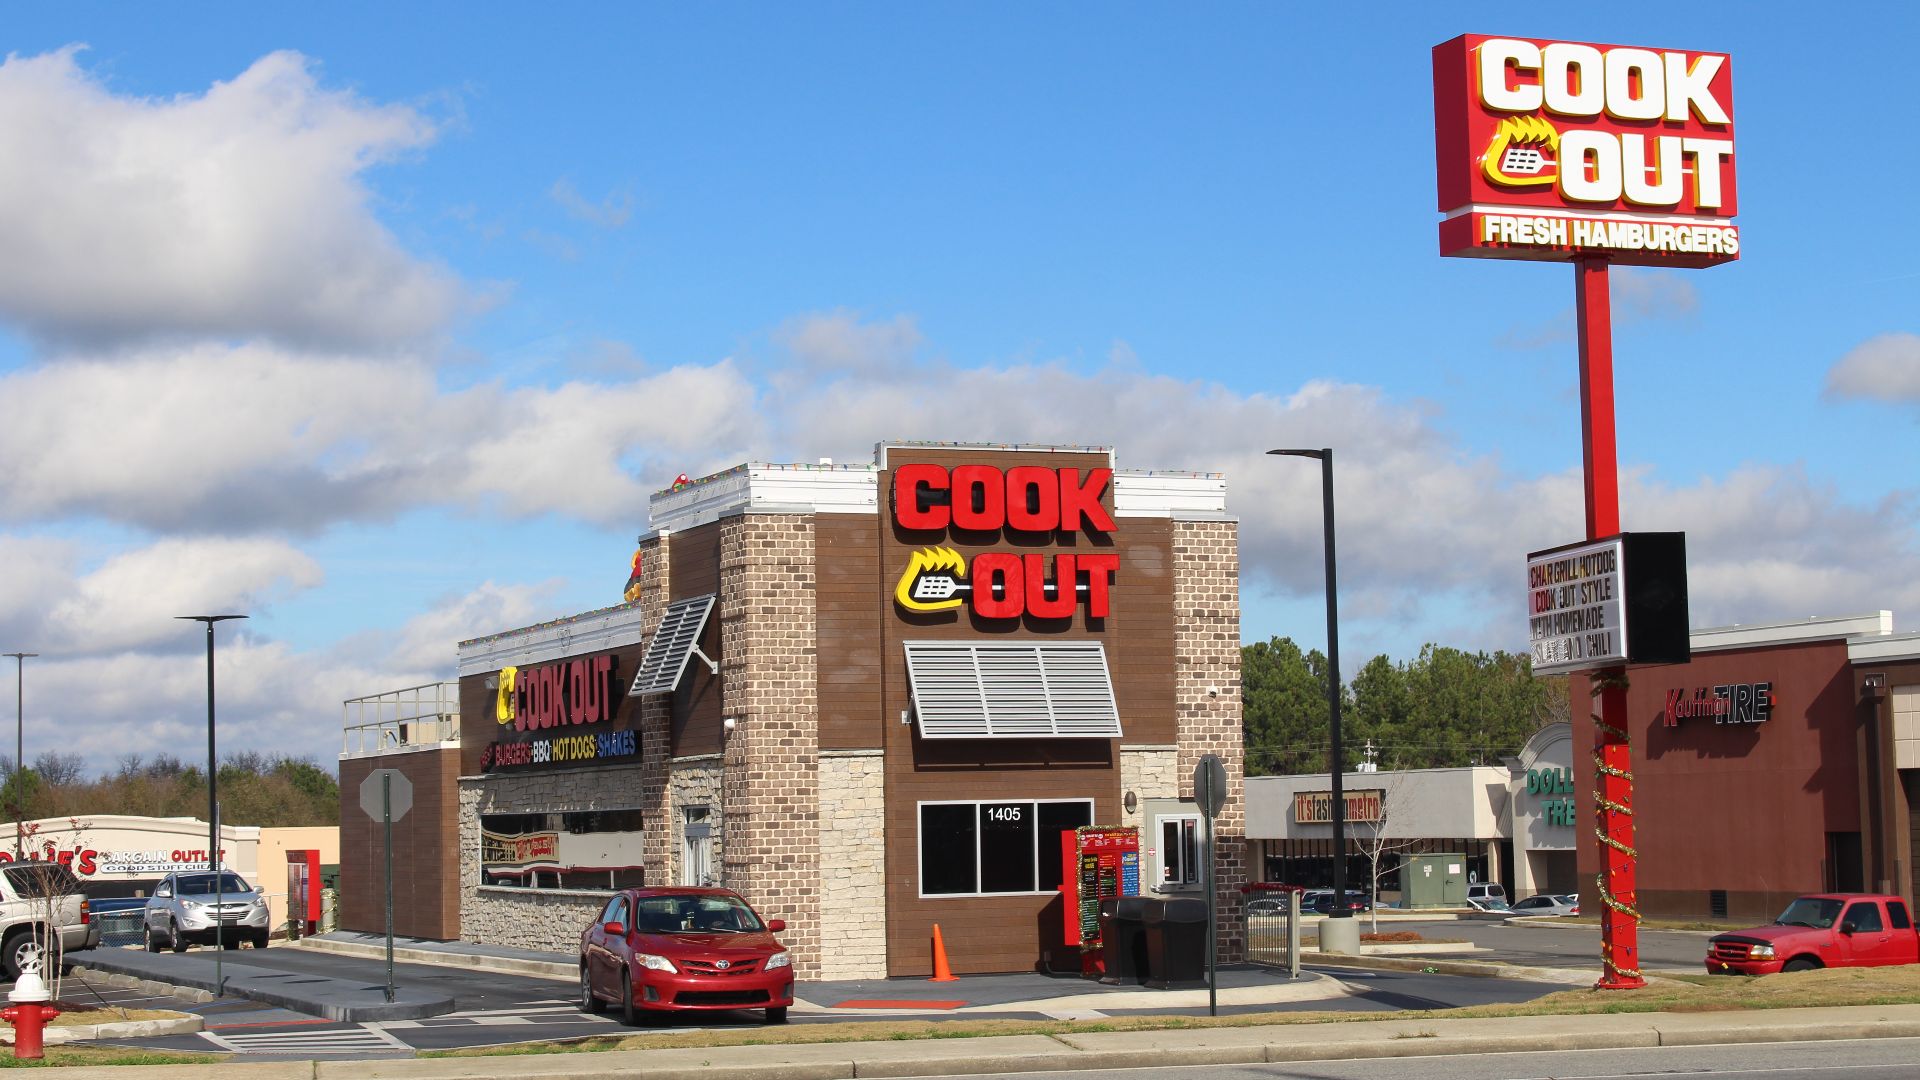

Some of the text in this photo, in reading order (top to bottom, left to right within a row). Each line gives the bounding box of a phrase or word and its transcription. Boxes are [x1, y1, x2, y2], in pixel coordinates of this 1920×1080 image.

[1479, 39, 1731, 124] COOK
[1559, 130, 1733, 208] OUT
[1483, 216, 1739, 254] FRESH HAMBURGERS
[895, 464, 1119, 531] COOK
[972, 553, 1120, 618] OUT
[1530, 549, 1616, 588] CHAR GRILL HOTDOG
[1535, 577, 1611, 613] COOK OUT STYLE
[1554, 605, 1604, 636] HOMEMADE
[1586, 632, 1611, 657] CHILI
[514, 655, 612, 732] COOK OUT
[1664, 682, 1769, 727] Kauffman TIRE
[495, 730, 635, 766] BURGERS BBQ HOT DOGS SHAKES
[988, 807, 1021, 821] 1405
[172, 850, 225, 862] OUTLT
